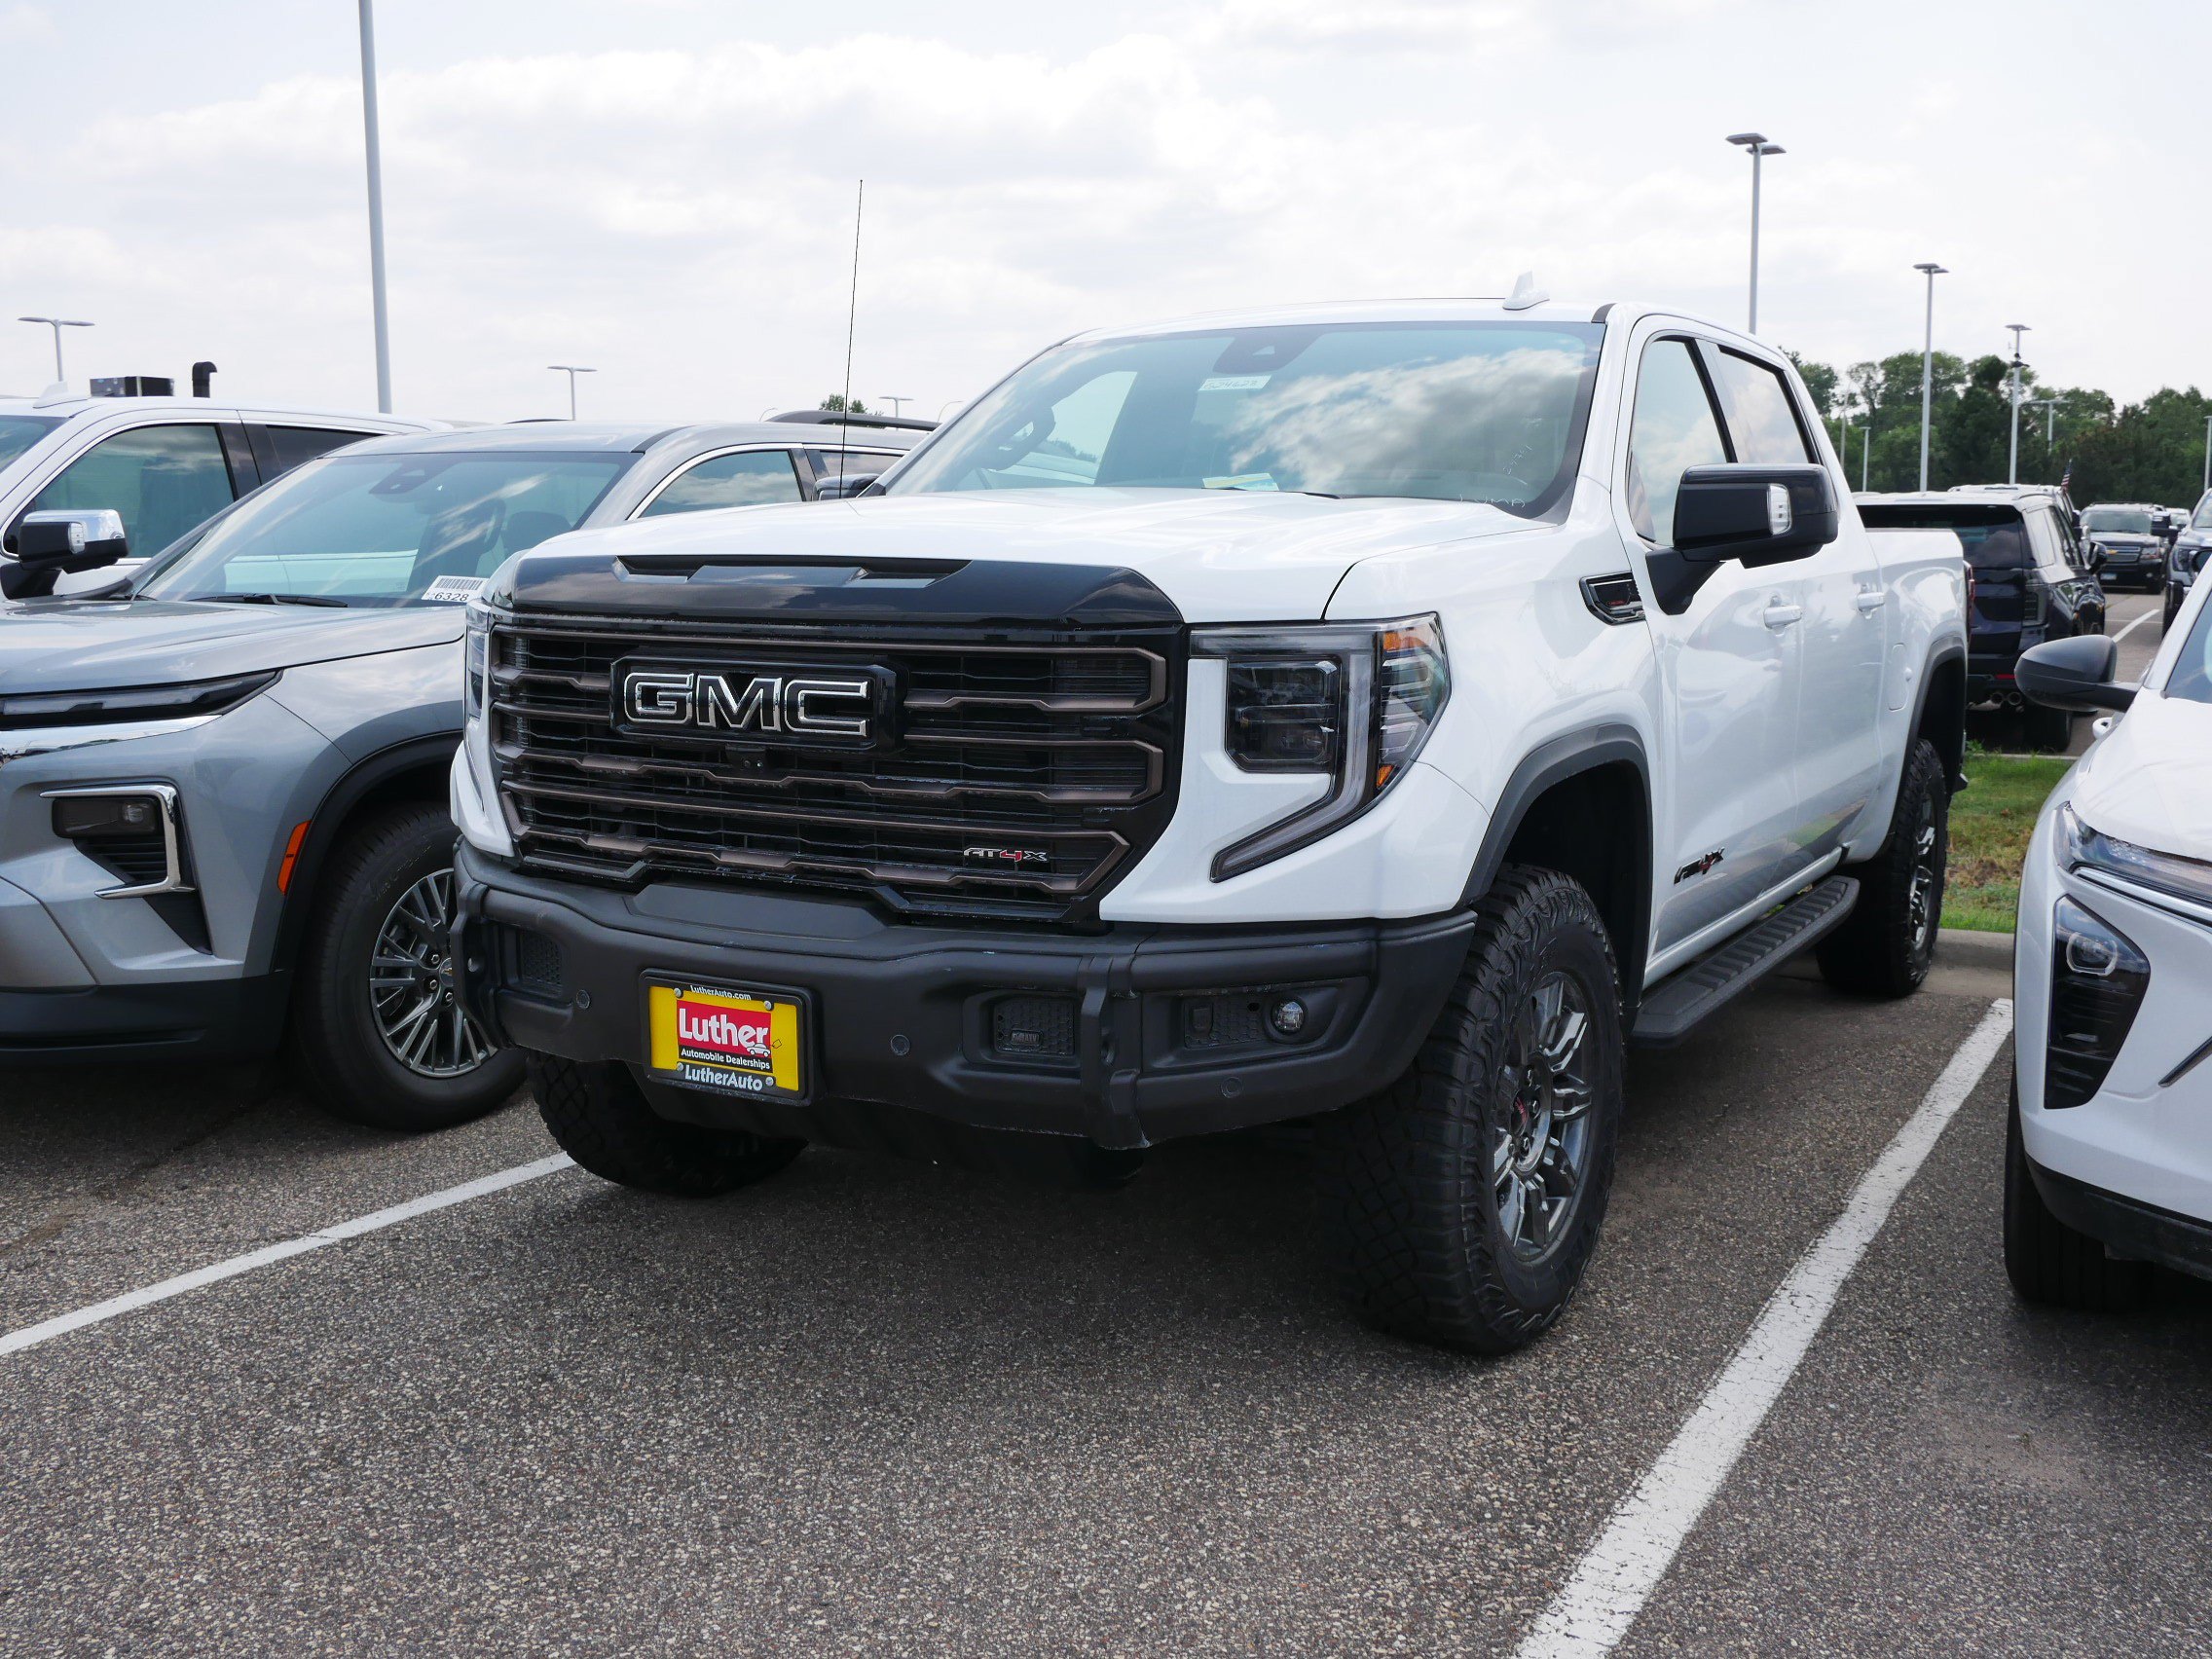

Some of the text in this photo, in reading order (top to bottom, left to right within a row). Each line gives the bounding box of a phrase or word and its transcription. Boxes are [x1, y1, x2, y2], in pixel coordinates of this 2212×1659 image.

[624, 672, 868, 737] GMC
[963, 847, 1049, 863] AT4X
[690, 985, 752, 1000] LutherAuto.com
[679, 1008, 769, 1050] Luther
[681, 1048, 771, 1070] Automobile Dealerships
[684, 1064, 763, 1091] LutherAuto
